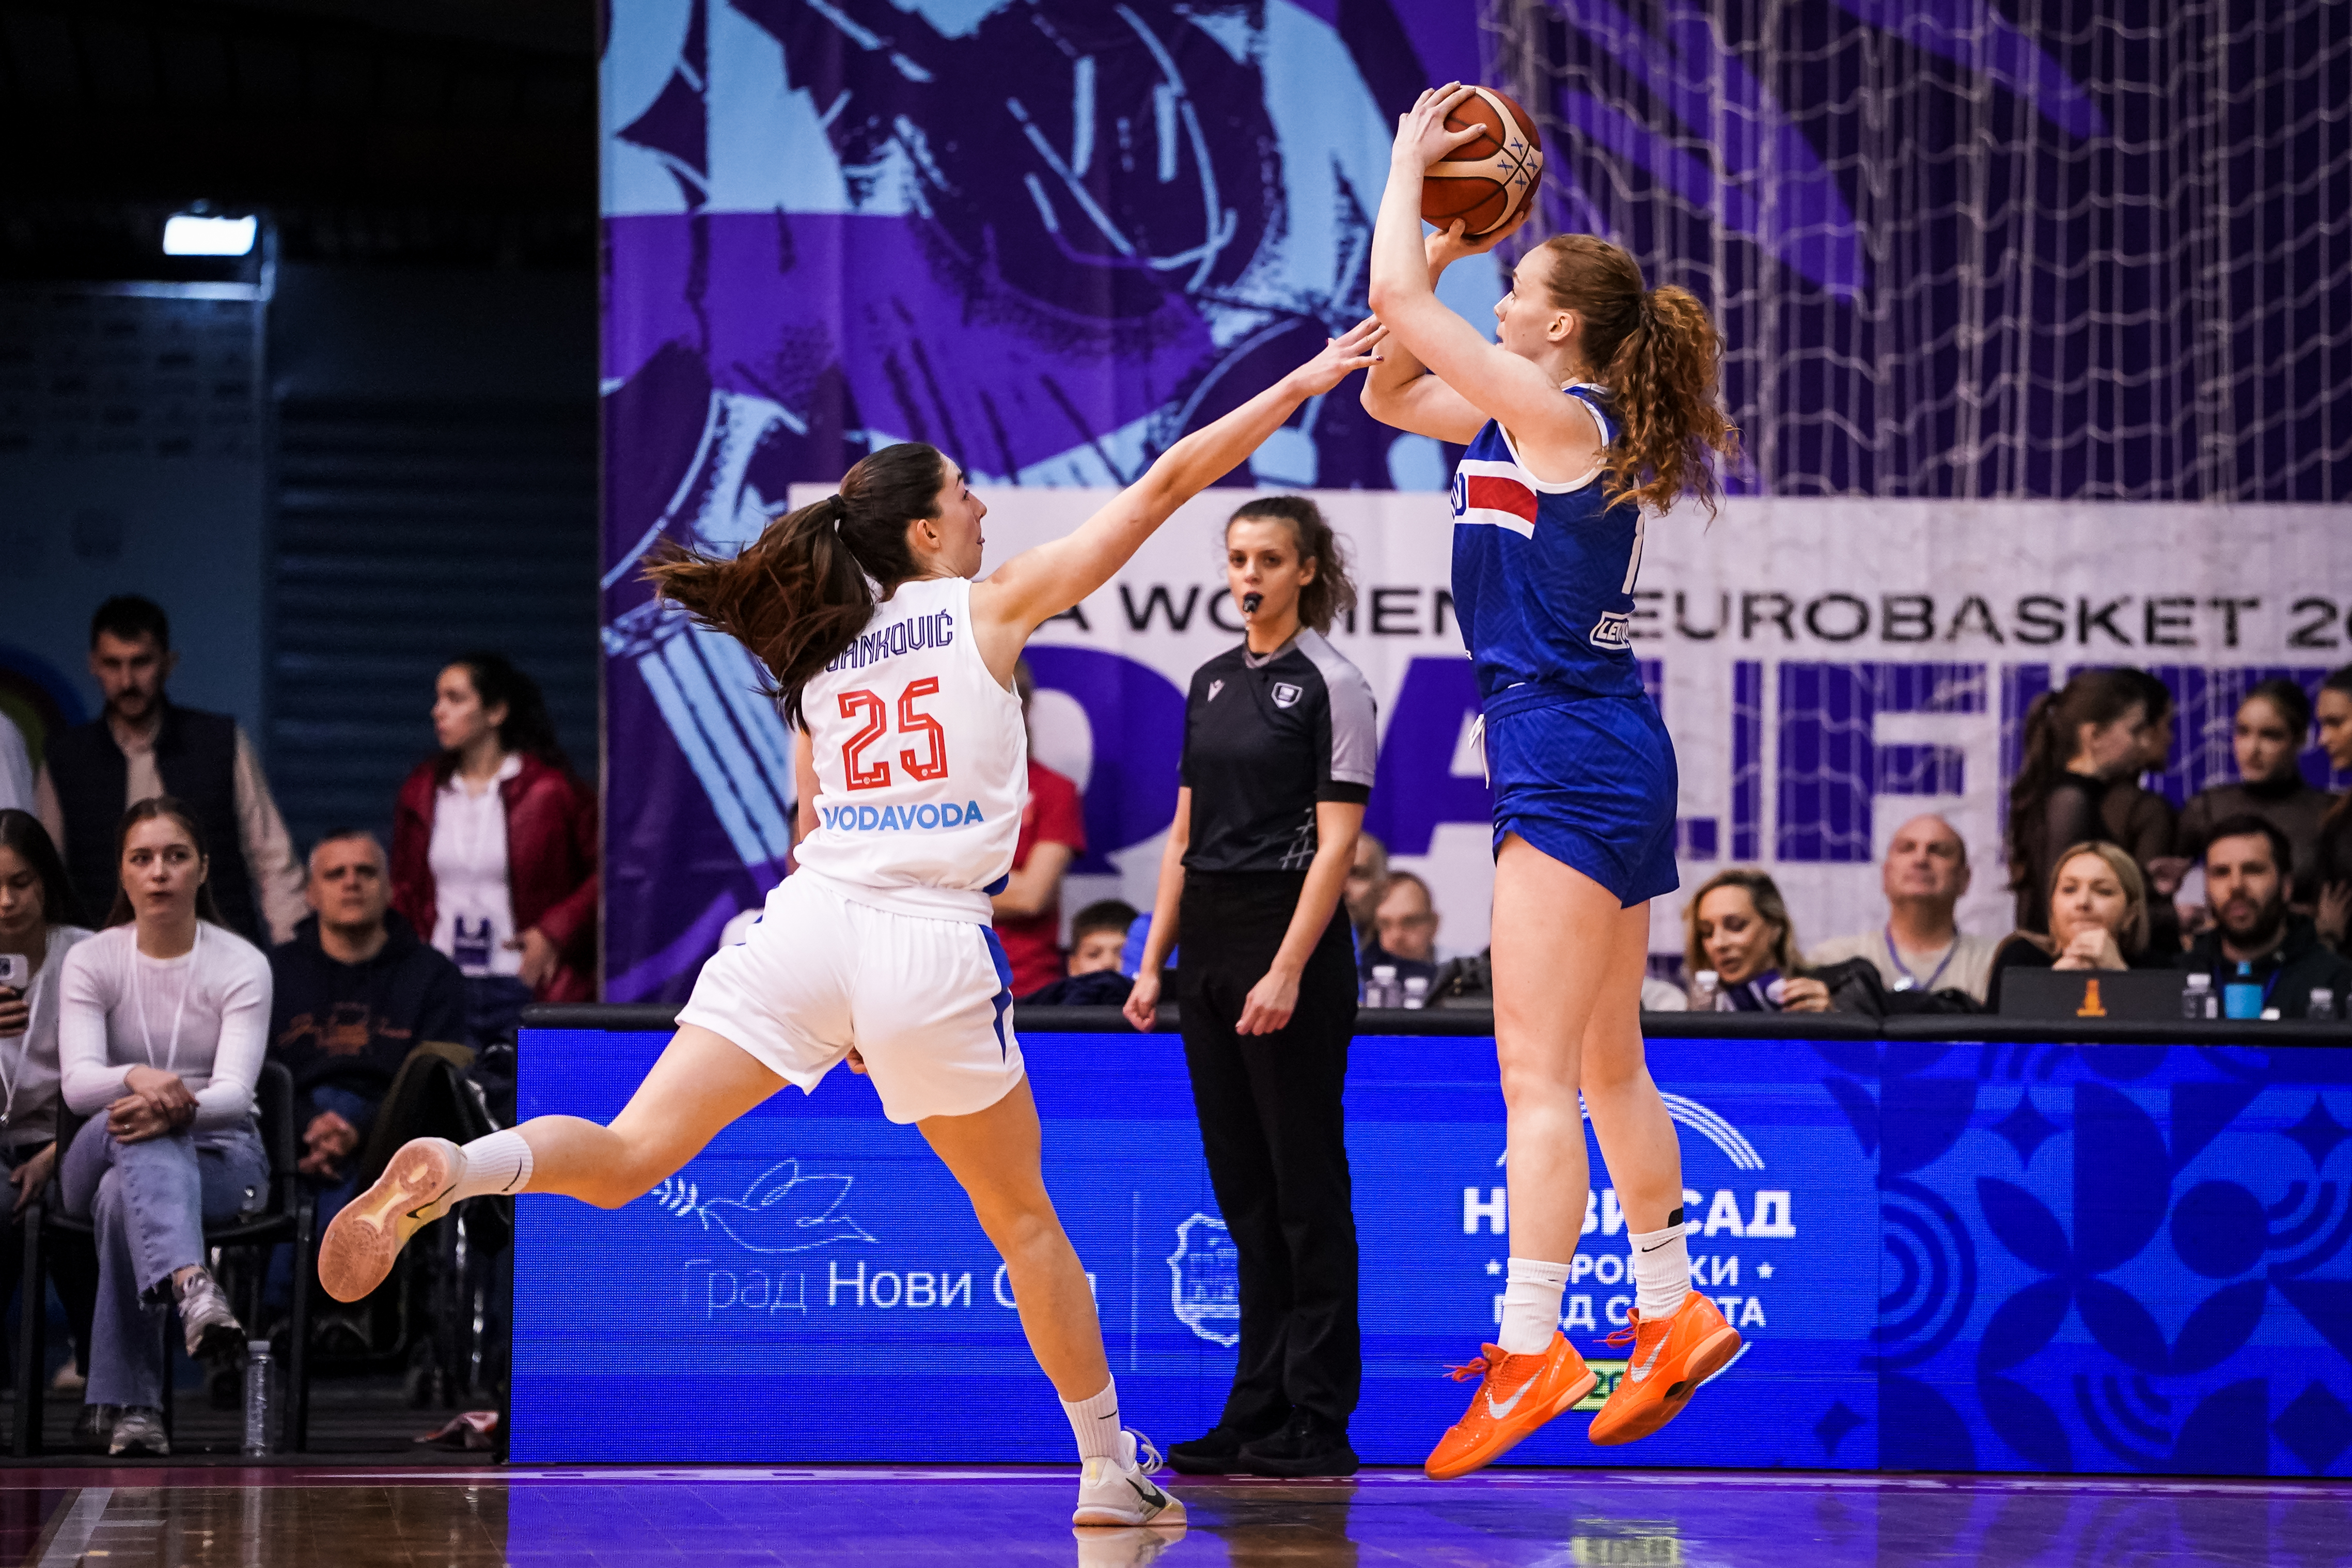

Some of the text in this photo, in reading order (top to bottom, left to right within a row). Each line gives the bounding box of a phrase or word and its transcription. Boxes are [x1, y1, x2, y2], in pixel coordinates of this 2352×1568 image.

[1630, 590, 2260, 648] EUROBASKET
[837, 676, 948, 791] 25
[822, 800, 984, 830] VODAVODA
[828, 1260, 971, 1308] Нови
